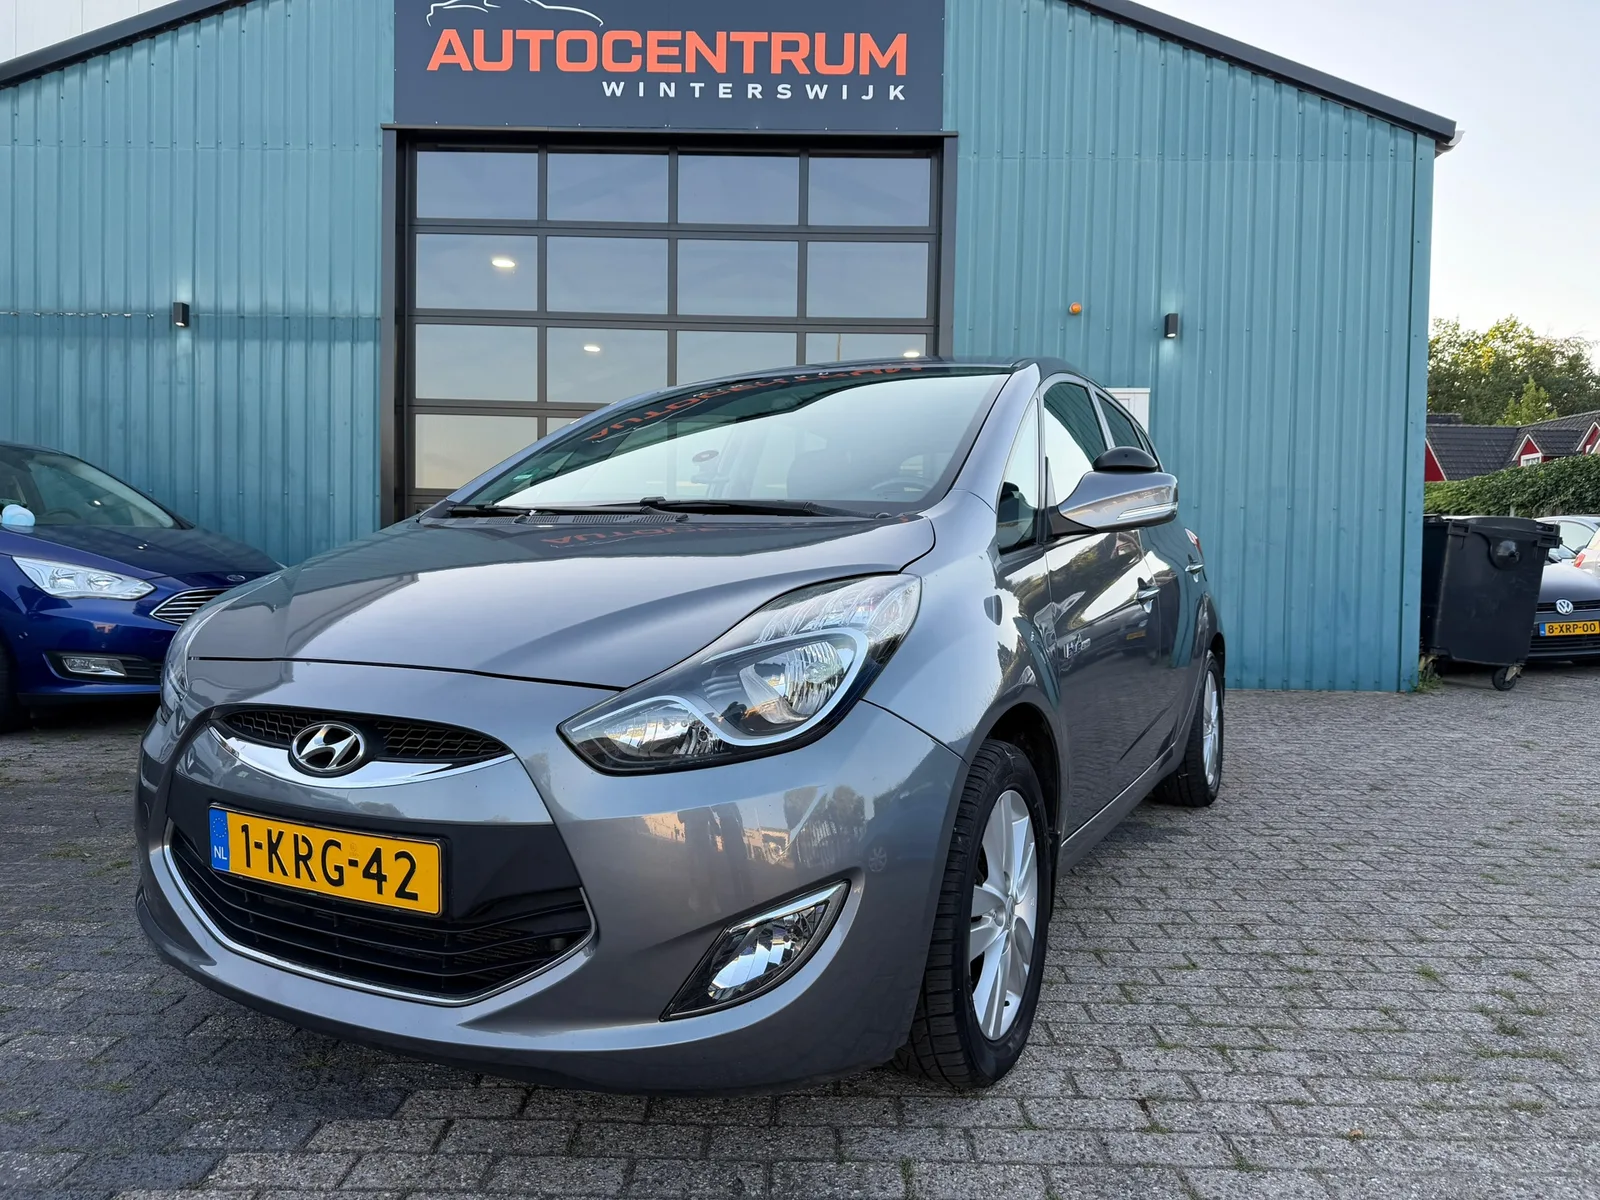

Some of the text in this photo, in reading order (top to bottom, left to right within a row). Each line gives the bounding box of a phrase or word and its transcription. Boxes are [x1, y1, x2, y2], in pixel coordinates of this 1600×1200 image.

[426, 28, 907, 76] AUTOCENTRUM
[602, 81, 906, 101] WINTERSWIJK
[1548, 623, 1597, 634] 8-XRP-00
[213, 844, 228, 860] NL
[240, 823, 419, 901] 1-KRG-42
